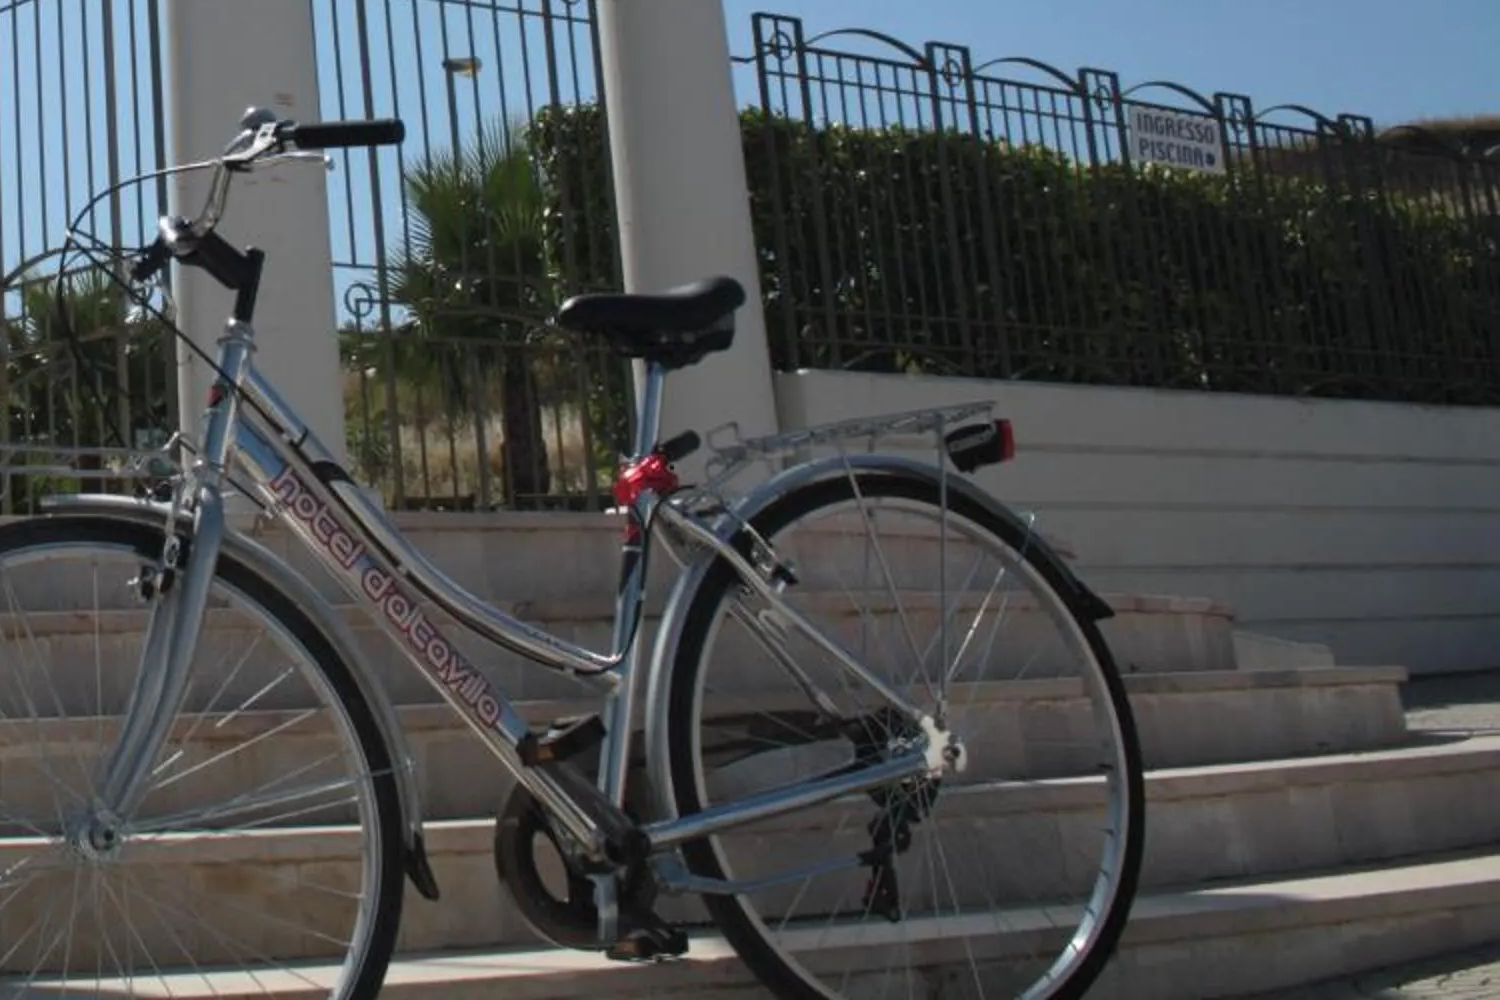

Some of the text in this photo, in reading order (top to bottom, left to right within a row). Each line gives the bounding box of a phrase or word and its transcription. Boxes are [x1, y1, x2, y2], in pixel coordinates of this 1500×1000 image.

[1136, 112, 1215, 145] INGRESSO
[1139, 138, 1204, 167] PISCINA
[269, 464, 365, 569] hotel
